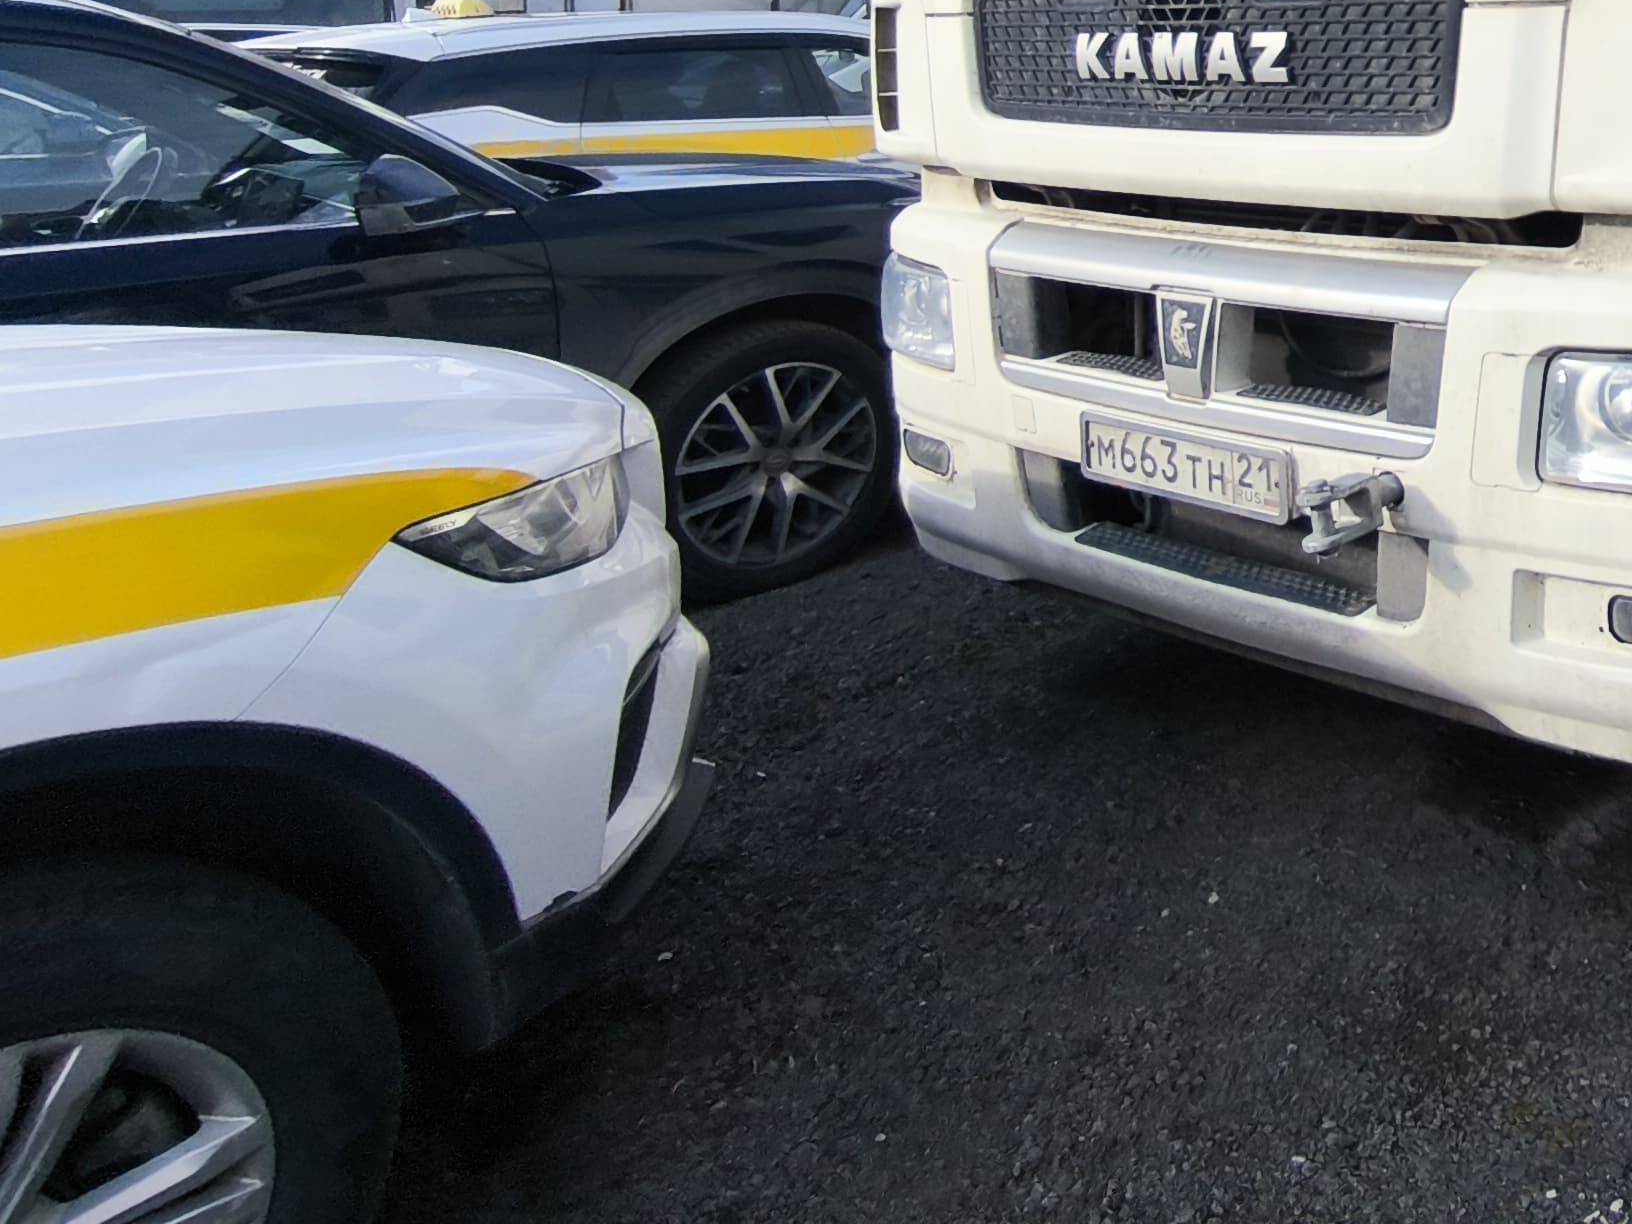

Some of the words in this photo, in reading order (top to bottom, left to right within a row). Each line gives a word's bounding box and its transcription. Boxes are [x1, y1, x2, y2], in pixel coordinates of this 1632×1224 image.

[1075, 31, 1290, 83] KAMAZ
[1237, 454, 1273, 493] 21
[1237, 489, 1263, 505] RUS
